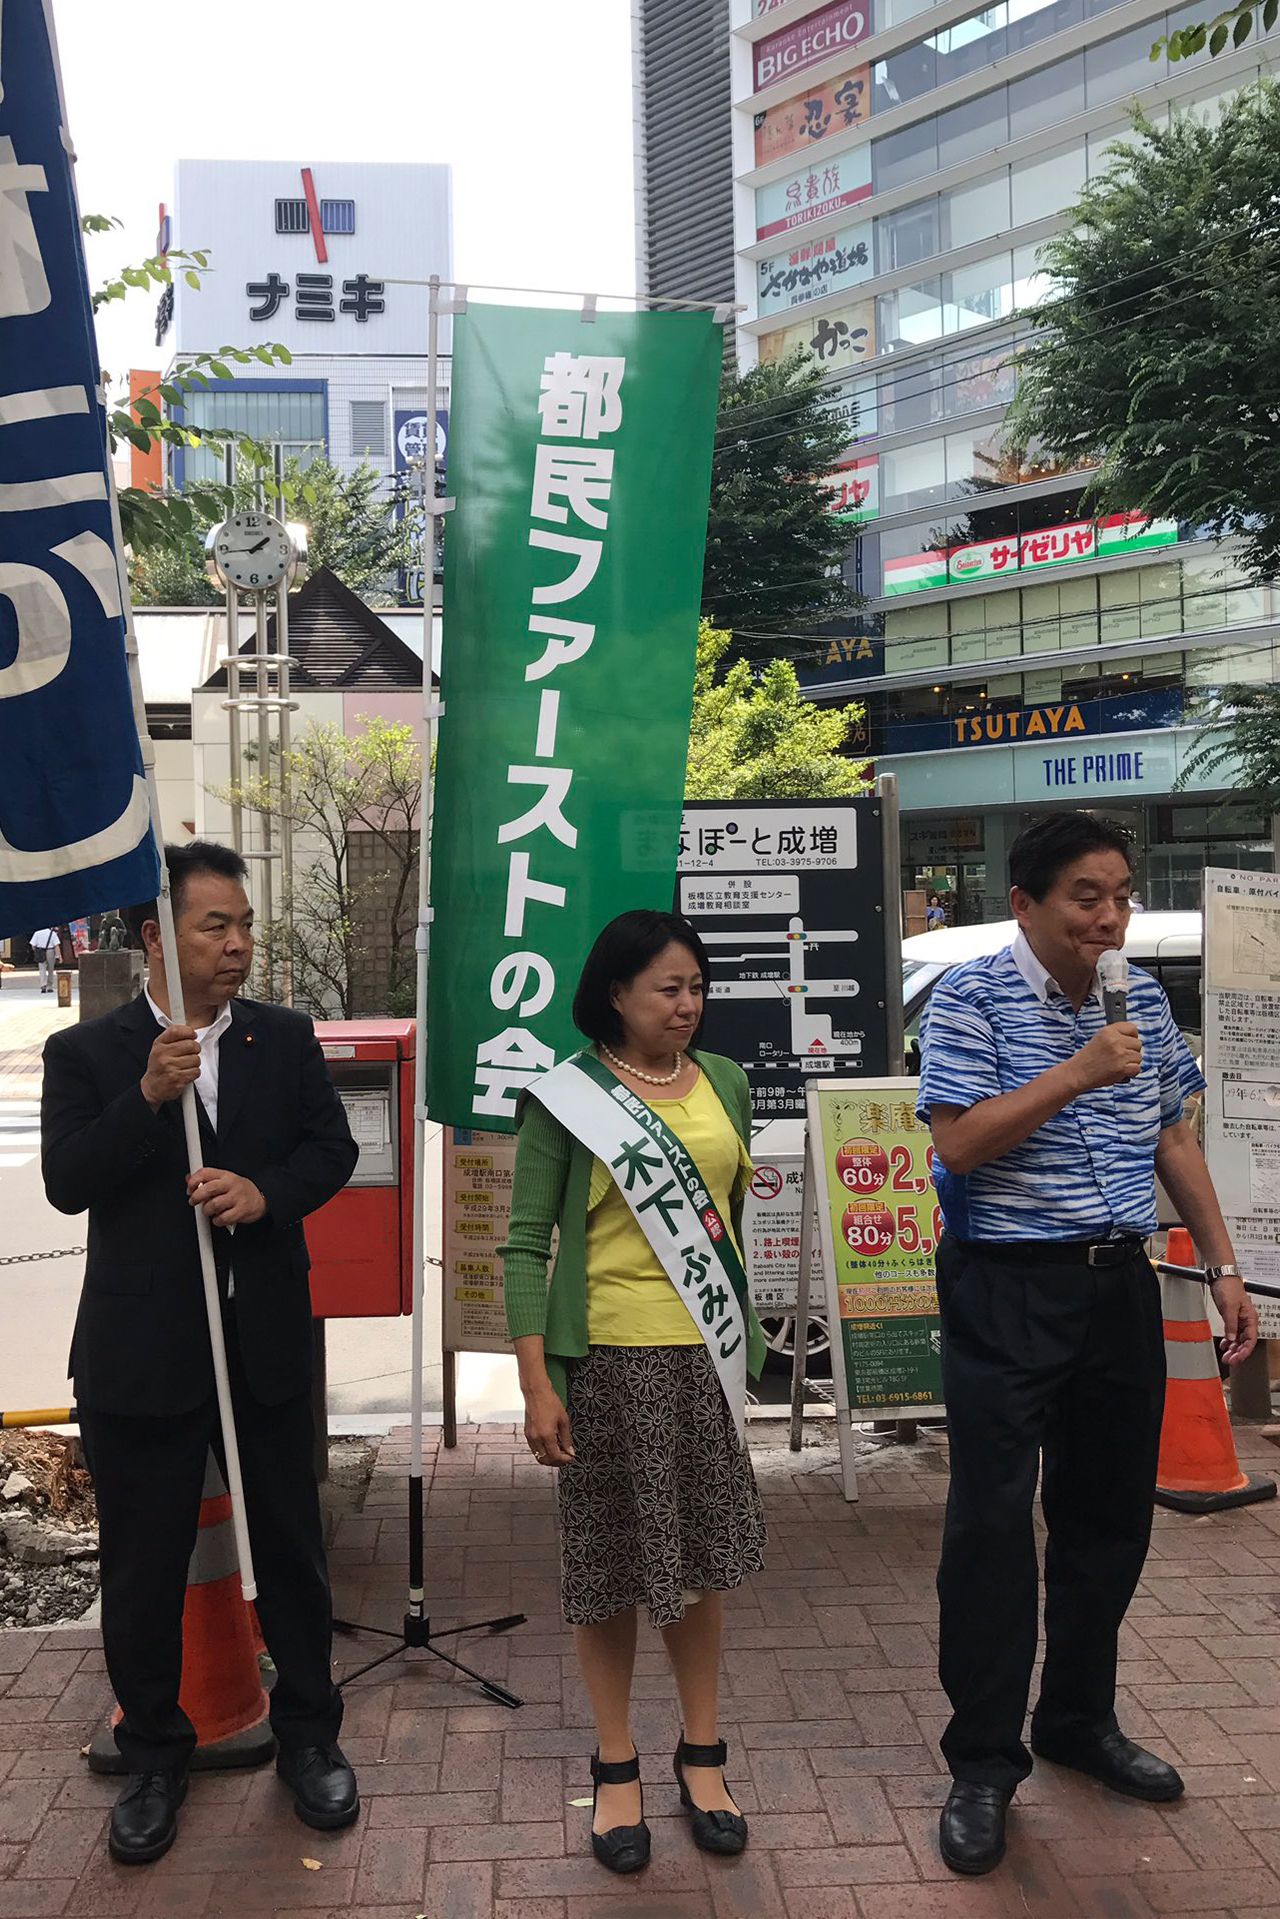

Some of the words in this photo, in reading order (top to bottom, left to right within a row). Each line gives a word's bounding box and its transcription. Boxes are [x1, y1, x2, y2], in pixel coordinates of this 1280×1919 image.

[757, 44, 797, 87] BIG
[802, 11, 864, 57] ECHO
[799, 80, 865, 139] 忍家
[785, 197, 841, 228] TORIKIZOKU
[760, 261, 775, 275] 5F
[246, 272, 385, 322] ナミキ
[245, 516, 260, 527] 12
[219, 544, 229, 555] 9
[279, 544, 288, 555] 3
[990, 532, 1093, 570] サイゼリヤ
[249, 573, 259, 584] 6
[955, 706, 1087, 742] TSUTAYA
[471, 351, 626, 1118] 都民ファーストの会
[1042, 757, 1076, 787] THE
[1083, 751, 1143, 782] PRIME
[755, 857, 839, 867] TEL:03-3975-9706
[1239, 874, 1254, 882] NO
[687, 890, 792, 901] 板橋区立教育支援センター
[687, 900, 751, 910] 成増教育相談室
[804, 1059, 831, 1069] 成増駅
[1222, 1071, 1242, 1080] 撤去日
[610, 1083, 711, 1211] 都民ファーストの会
[842, 1167, 885, 1186] 60分
[852, 1214, 883, 1226] 組合せ
[847, 1226, 893, 1246] 80分
[775, 1262, 786, 1270] City
[754, 1293, 785, 1301] 板橋区
